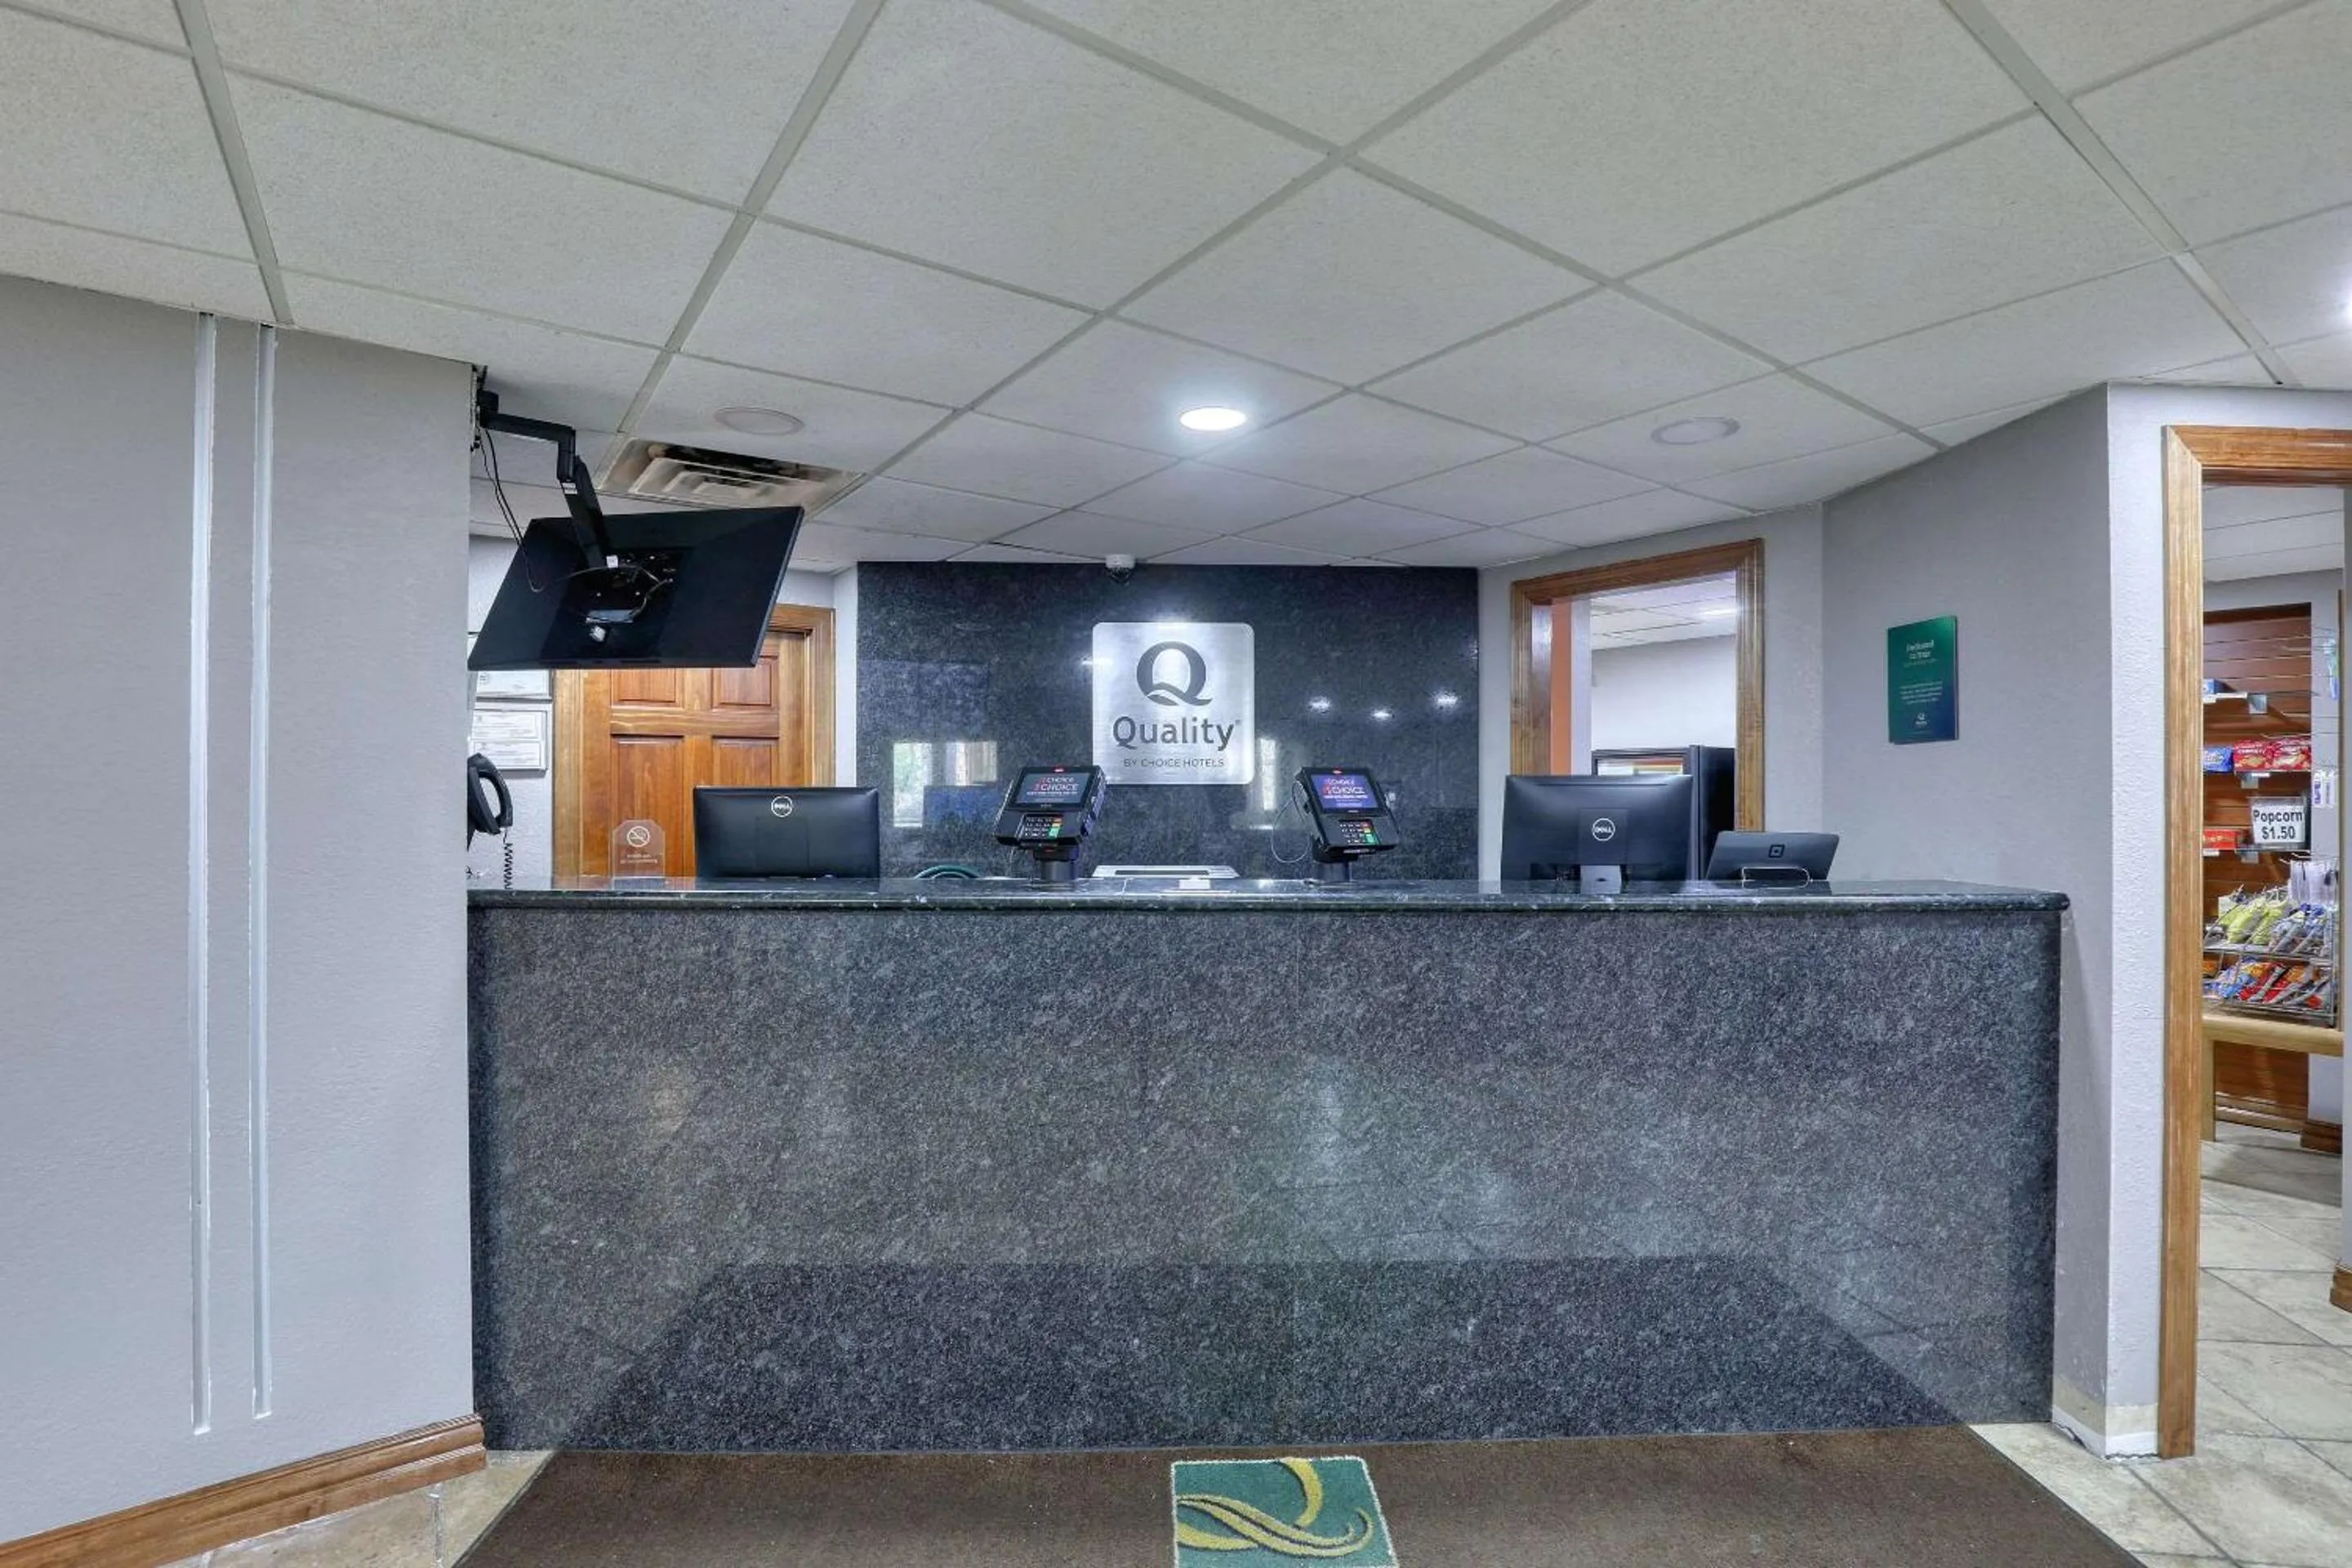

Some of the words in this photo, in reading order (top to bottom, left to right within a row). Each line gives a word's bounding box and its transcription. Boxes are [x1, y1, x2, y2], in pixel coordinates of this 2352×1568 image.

[1136, 641, 1213, 706] Q
[1112, 715, 1235, 751] Quality
[1124, 758, 1138, 768] BY
[1141, 758, 1180, 768] CHOICE
[1184, 758, 1224, 768] HOTELS
[2253, 809, 2303, 825] Popcorn
[2261, 826, 2296, 840] $1.50
